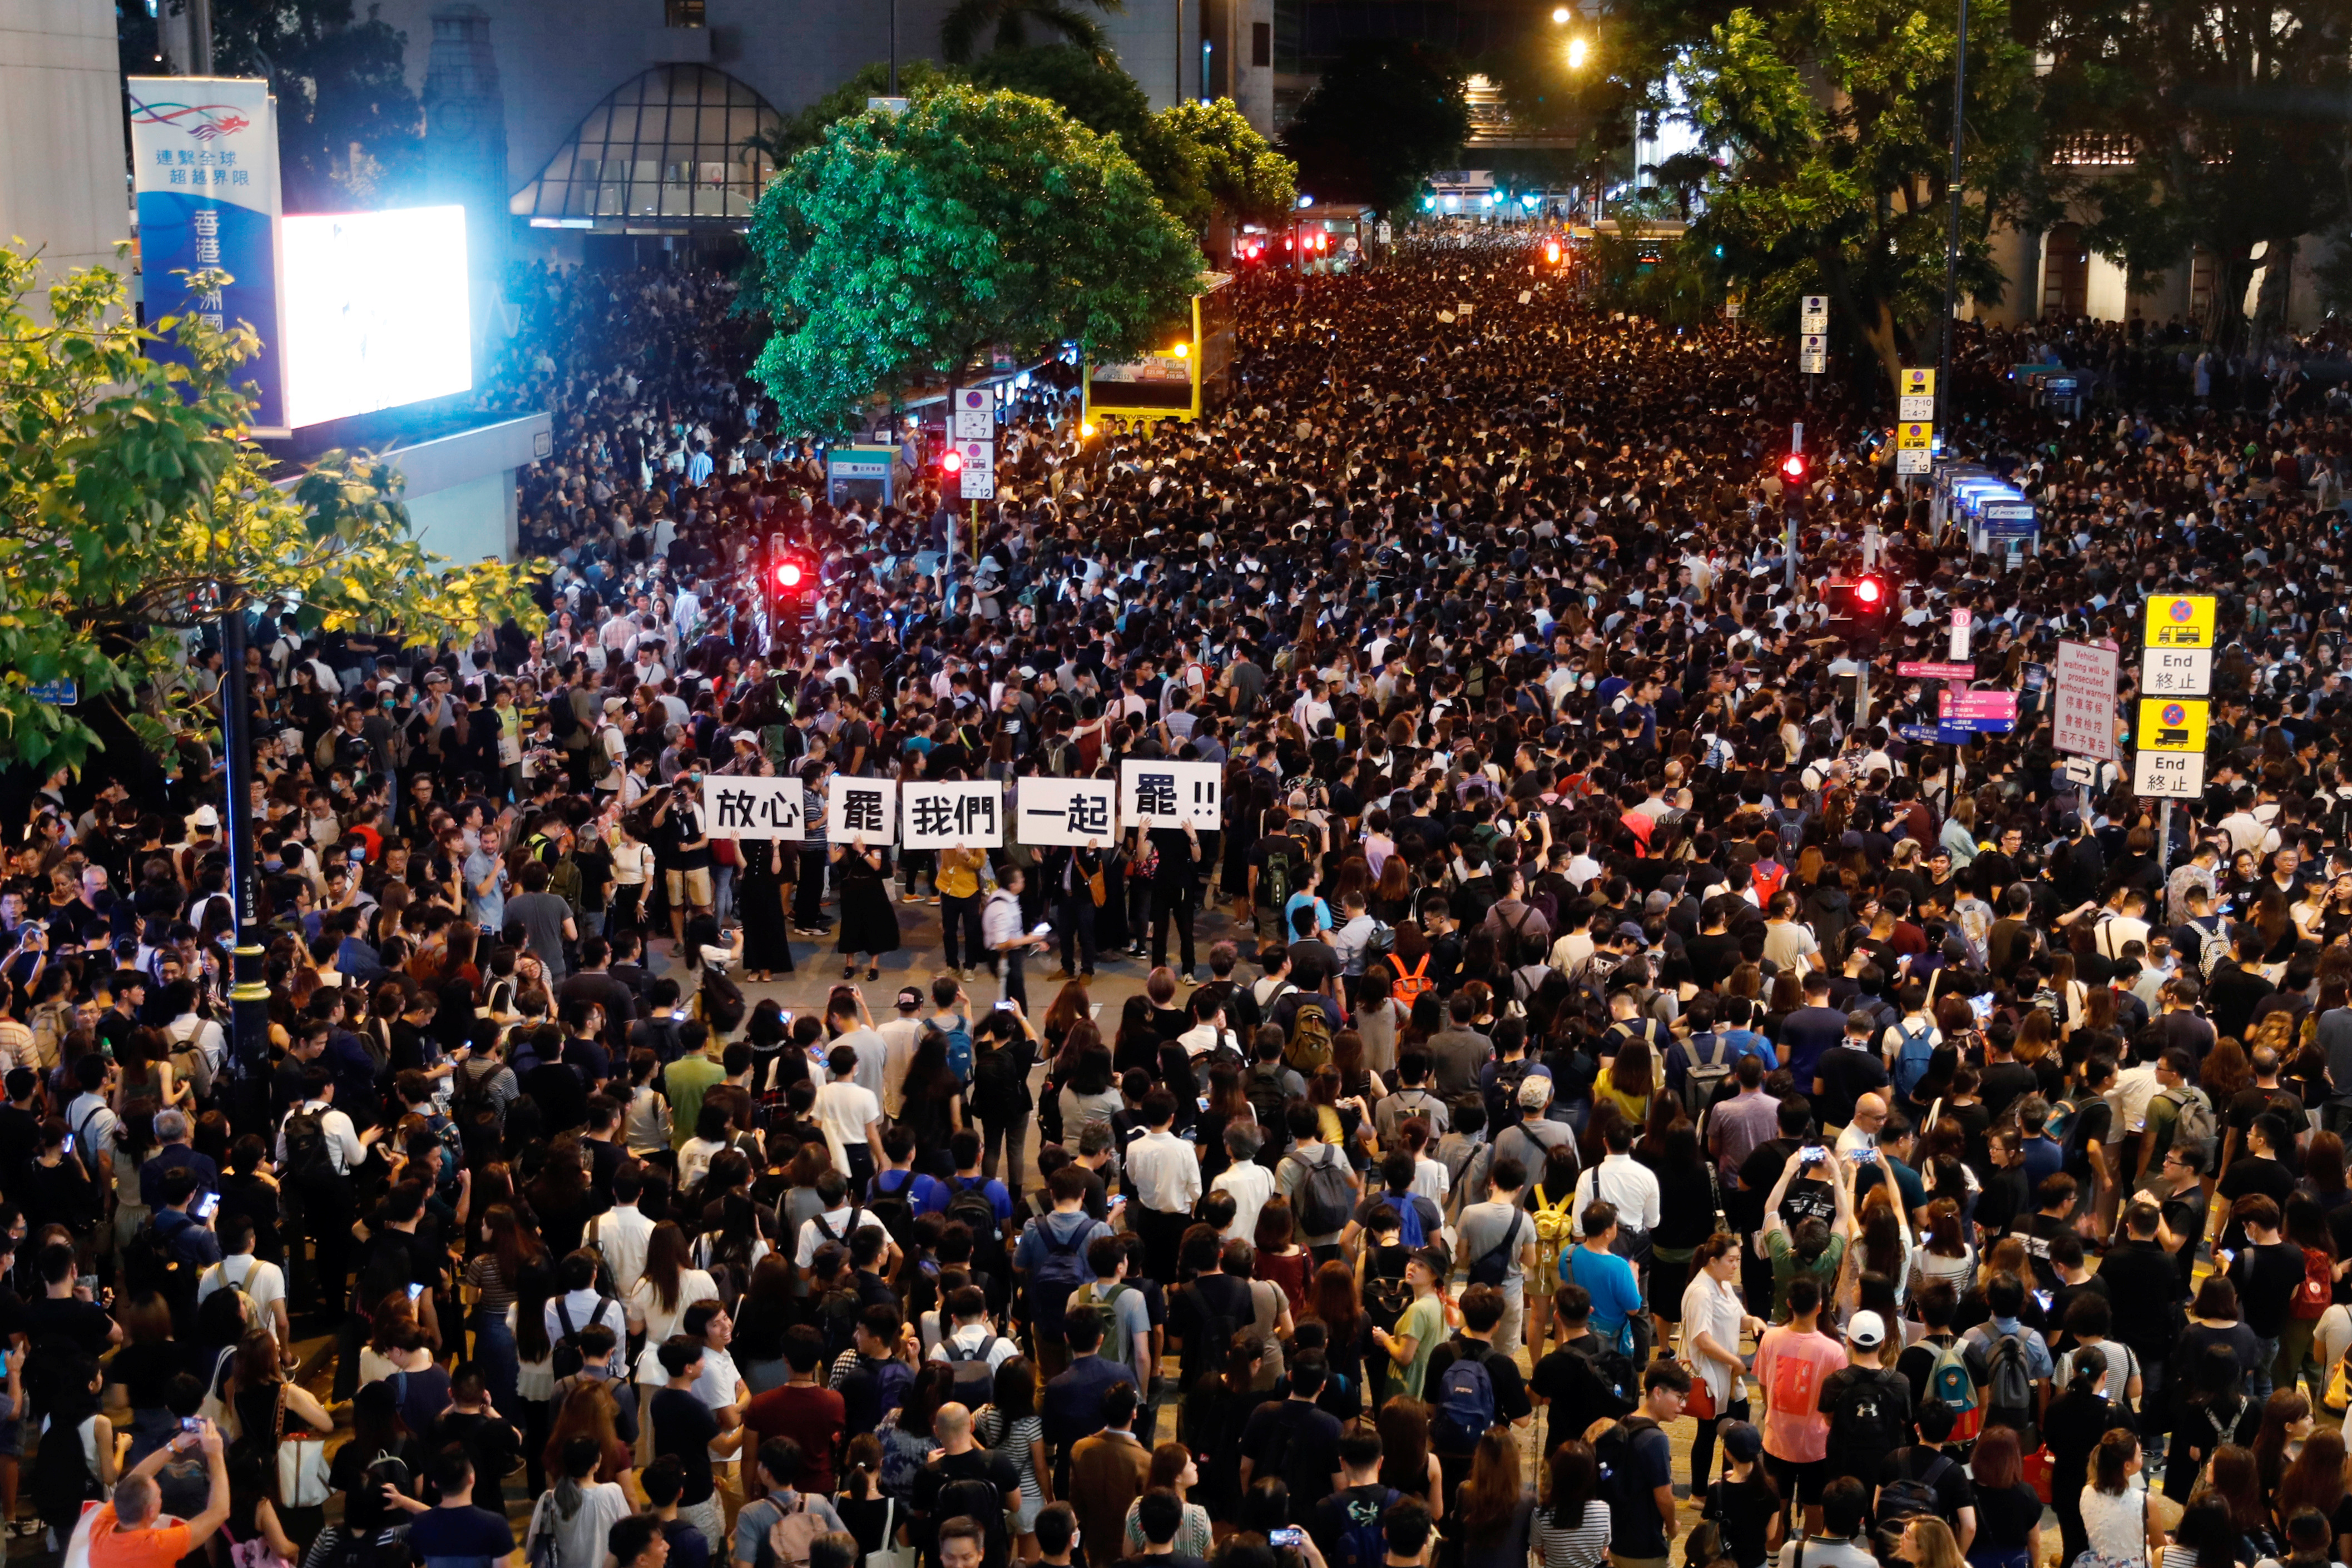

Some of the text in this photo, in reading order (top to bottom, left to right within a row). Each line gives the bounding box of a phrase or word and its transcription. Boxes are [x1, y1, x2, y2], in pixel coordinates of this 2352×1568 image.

[156, 149, 237, 167] 連繫全球
[170, 169, 250, 186] 超越界限
[980, 414, 986, 423] 7
[980, 428, 986, 436] 7
[979, 474, 986, 482] 7
[979, 488, 991, 498] 12
[2076, 649, 2099, 662] Vehicle
[2163, 655, 2192, 667] End
[2063, 661, 2110, 677] waiting will be
[2068, 674, 2104, 687] prosecuted
[2155, 672, 2196, 689] 終止
[2059, 682, 2111, 702] without warning
[2066, 696, 2103, 716] 停車等候
[2065, 714, 2102, 734] 會被檢控
[2059, 730, 2106, 753] 而不予警告
[2155, 757, 2186, 770] End
[2147, 774, 2188, 792] 終止
[717, 787, 800, 828] 放心
[843, 790, 885, 832] 罷
[912, 792, 995, 836] 我們
[1027, 793, 1107, 834] 一起
[245, 875, 254, 917] 41659
